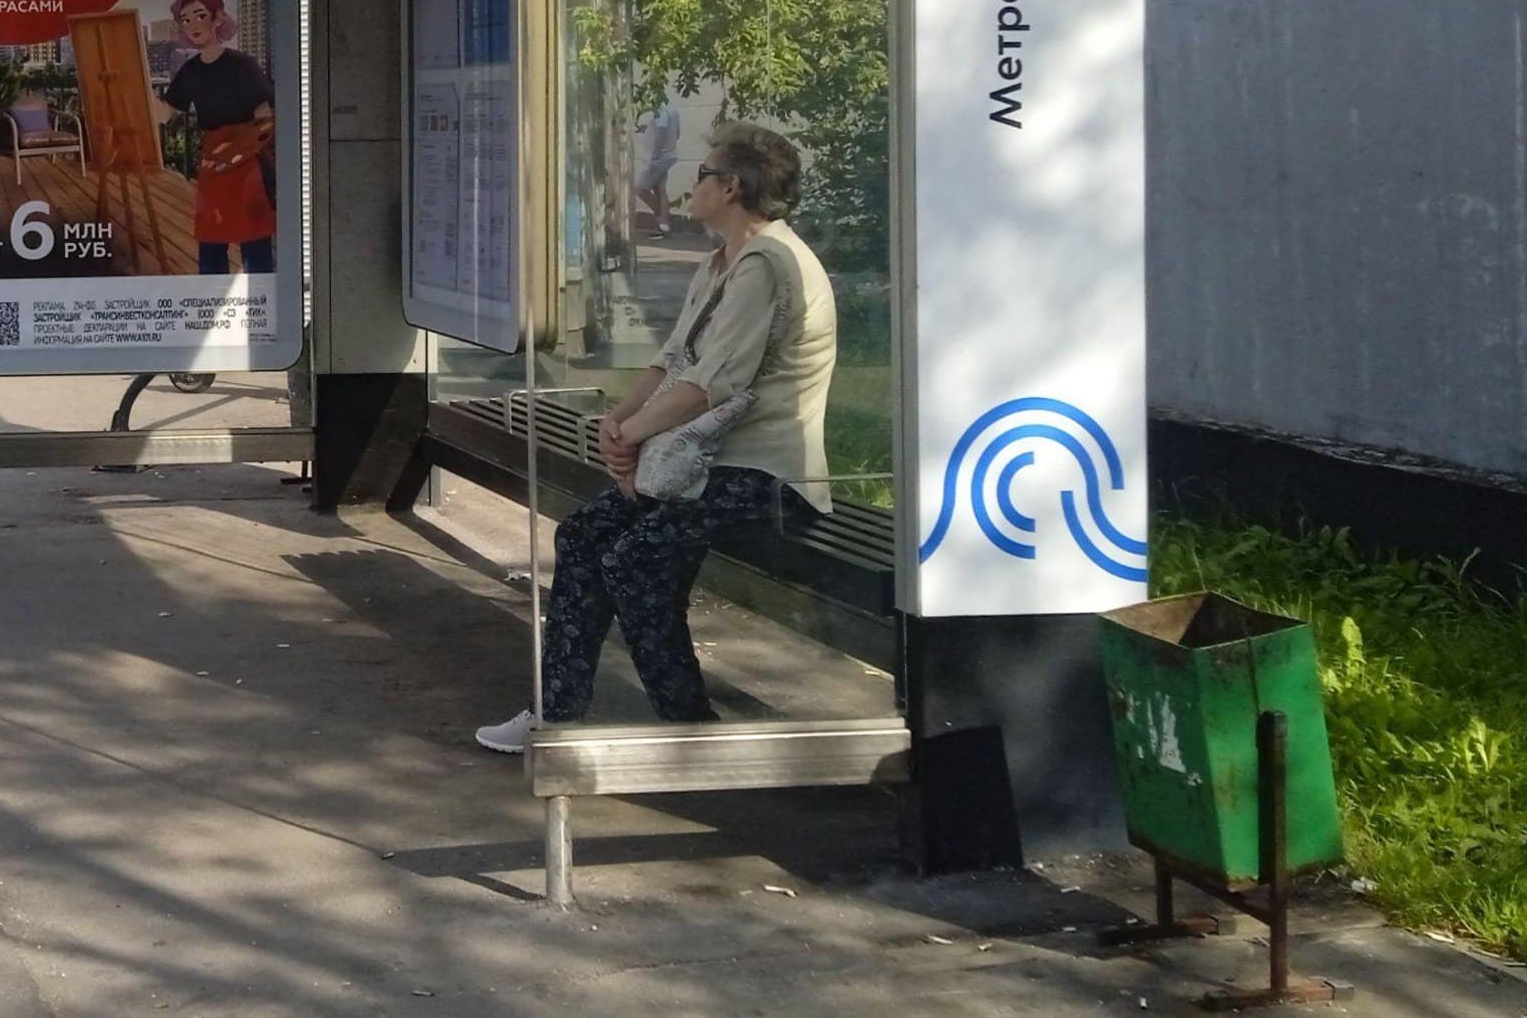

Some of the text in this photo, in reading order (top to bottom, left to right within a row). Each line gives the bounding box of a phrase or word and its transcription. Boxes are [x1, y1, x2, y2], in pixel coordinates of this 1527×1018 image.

[10, 200, 55, 261] 6
[64, 223, 112, 239] МЛН
[64, 242, 112, 258] РУБ.
